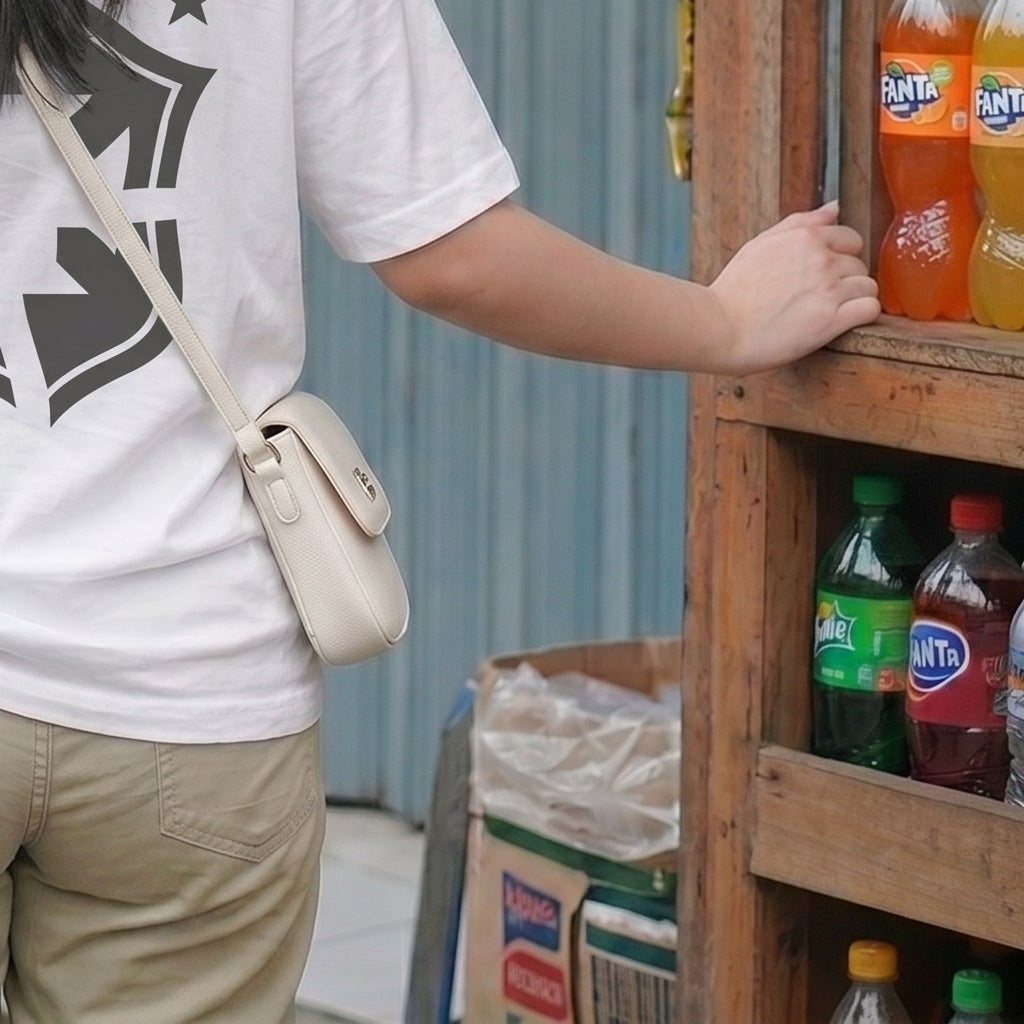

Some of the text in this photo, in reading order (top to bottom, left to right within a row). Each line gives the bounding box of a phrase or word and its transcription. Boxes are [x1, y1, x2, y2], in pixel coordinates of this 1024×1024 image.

[881, 73, 939, 104] FANTA
[975, 86, 1024, 117] FANT
[910, 636, 961, 668] ANTA
